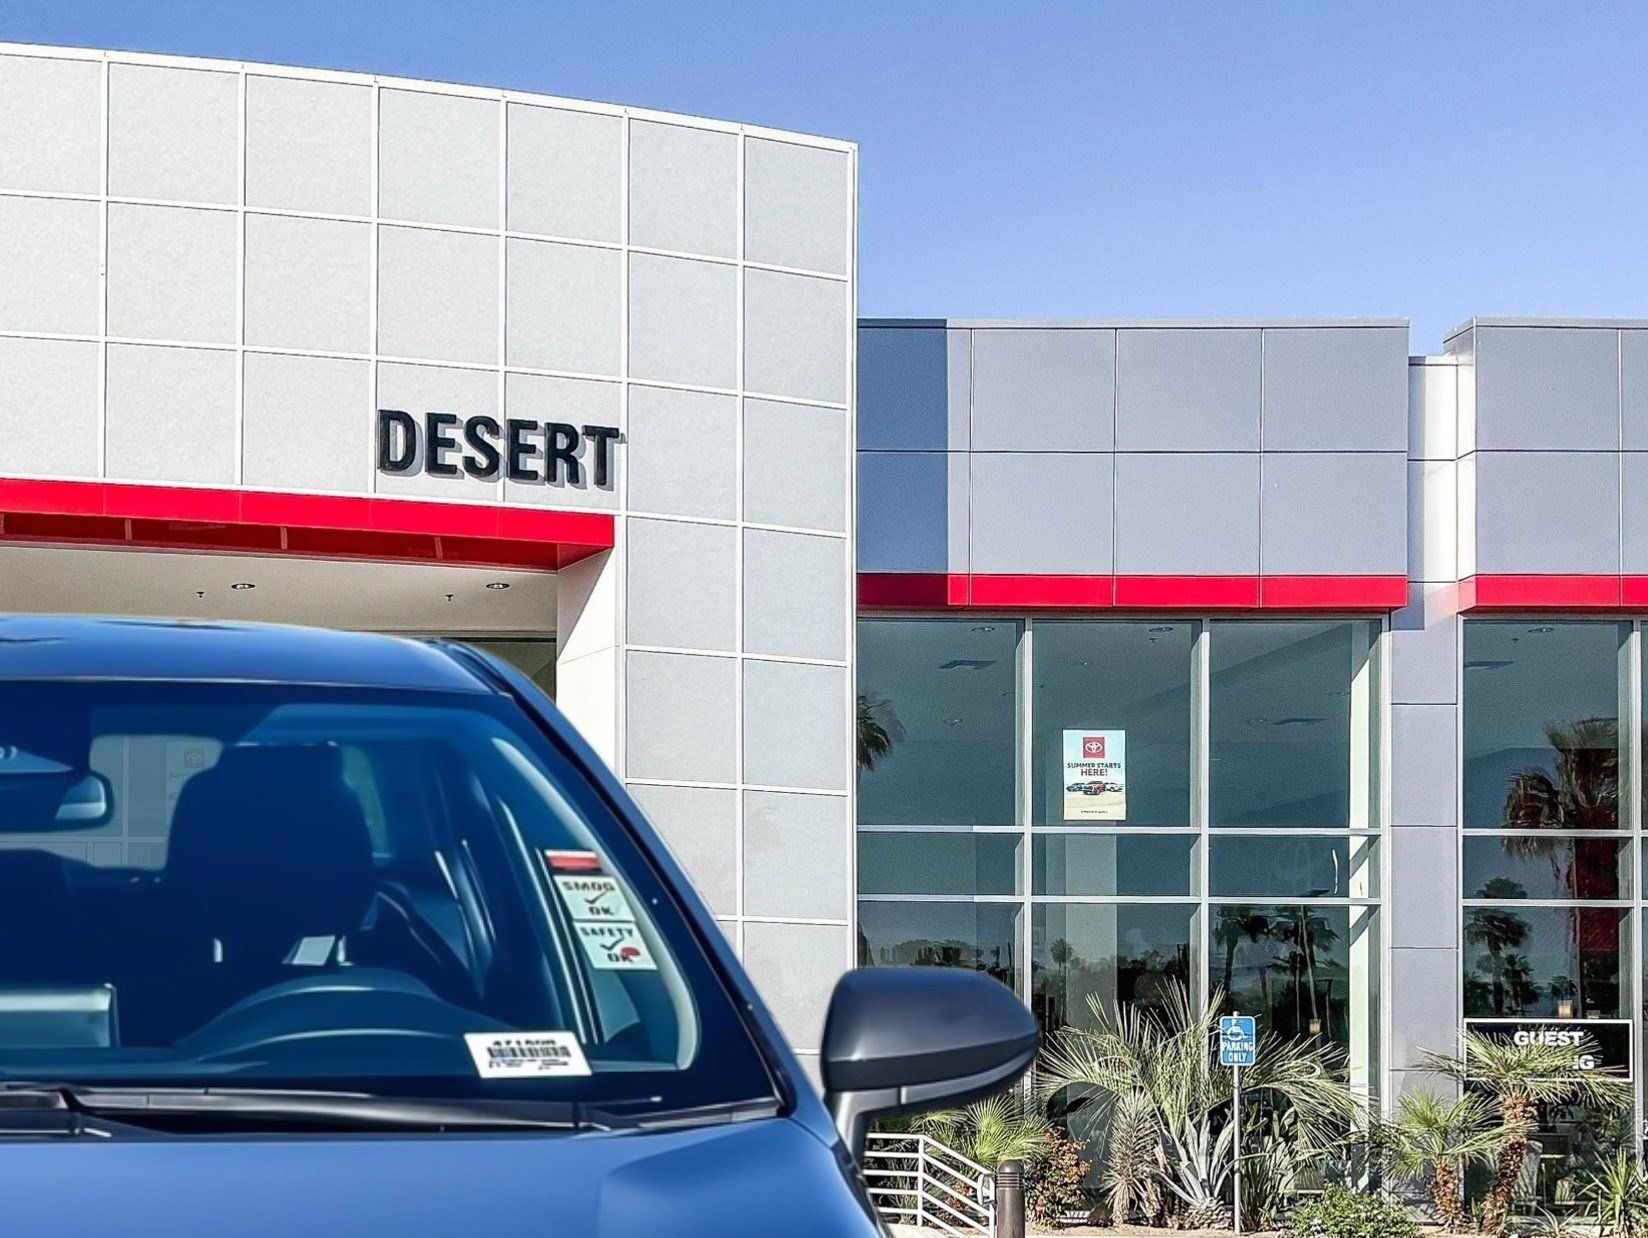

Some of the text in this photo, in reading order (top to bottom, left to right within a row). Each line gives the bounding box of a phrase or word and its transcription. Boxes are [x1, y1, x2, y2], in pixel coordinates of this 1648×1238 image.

[376, 408, 620, 487] DESERT
[1081, 768, 1108, 776] HERE!
[562, 882, 615, 891] SMOG
[580, 927, 633, 937] SAFETY
[1514, 1030, 1584, 1047] GUEST
[1222, 1041, 1253, 1051] PARKING
[1228, 1052, 1247, 1062] ONLY
